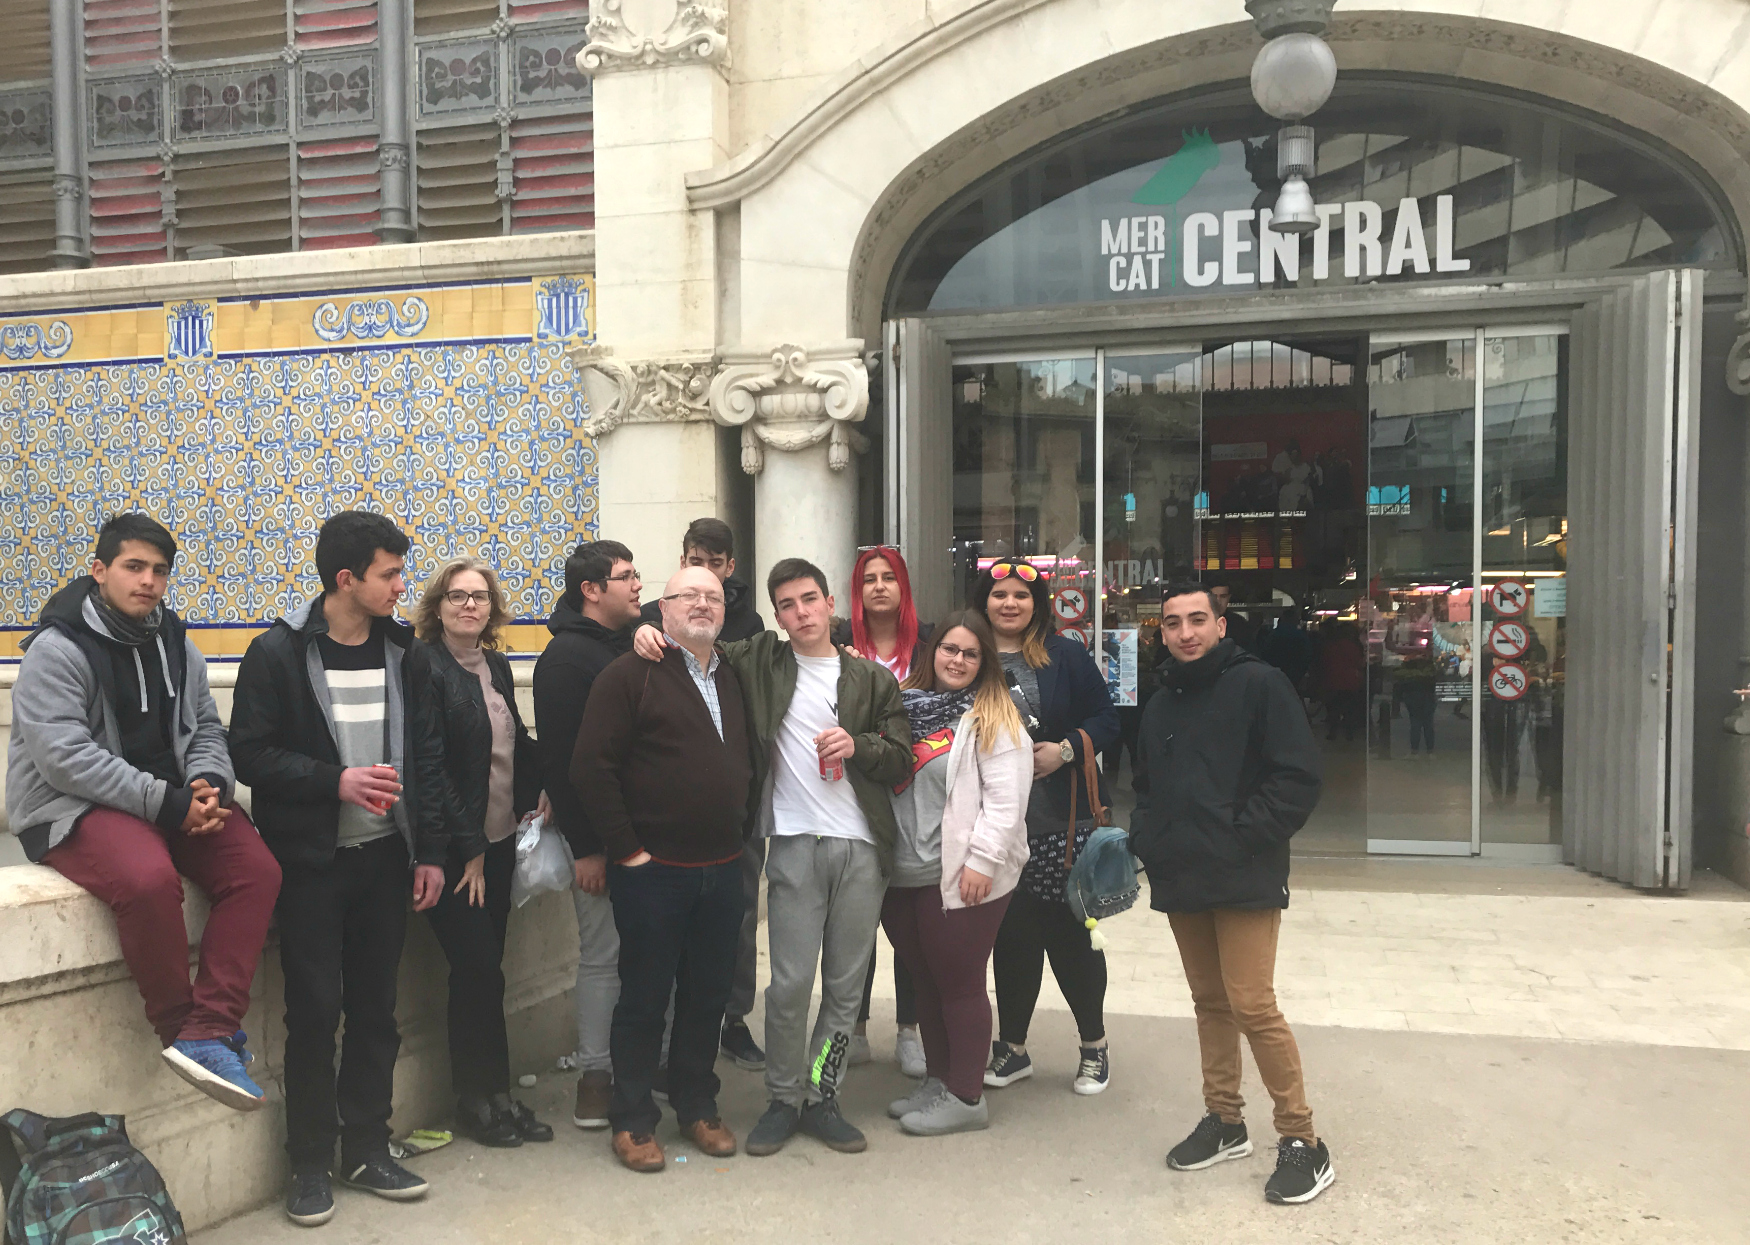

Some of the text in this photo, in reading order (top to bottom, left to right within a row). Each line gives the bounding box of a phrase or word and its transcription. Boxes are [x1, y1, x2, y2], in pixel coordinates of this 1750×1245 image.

[1101, 215, 1165, 255] MER
[1183, 194, 1471, 287] CENTRAL
[1109, 252, 1165, 292] CAT
